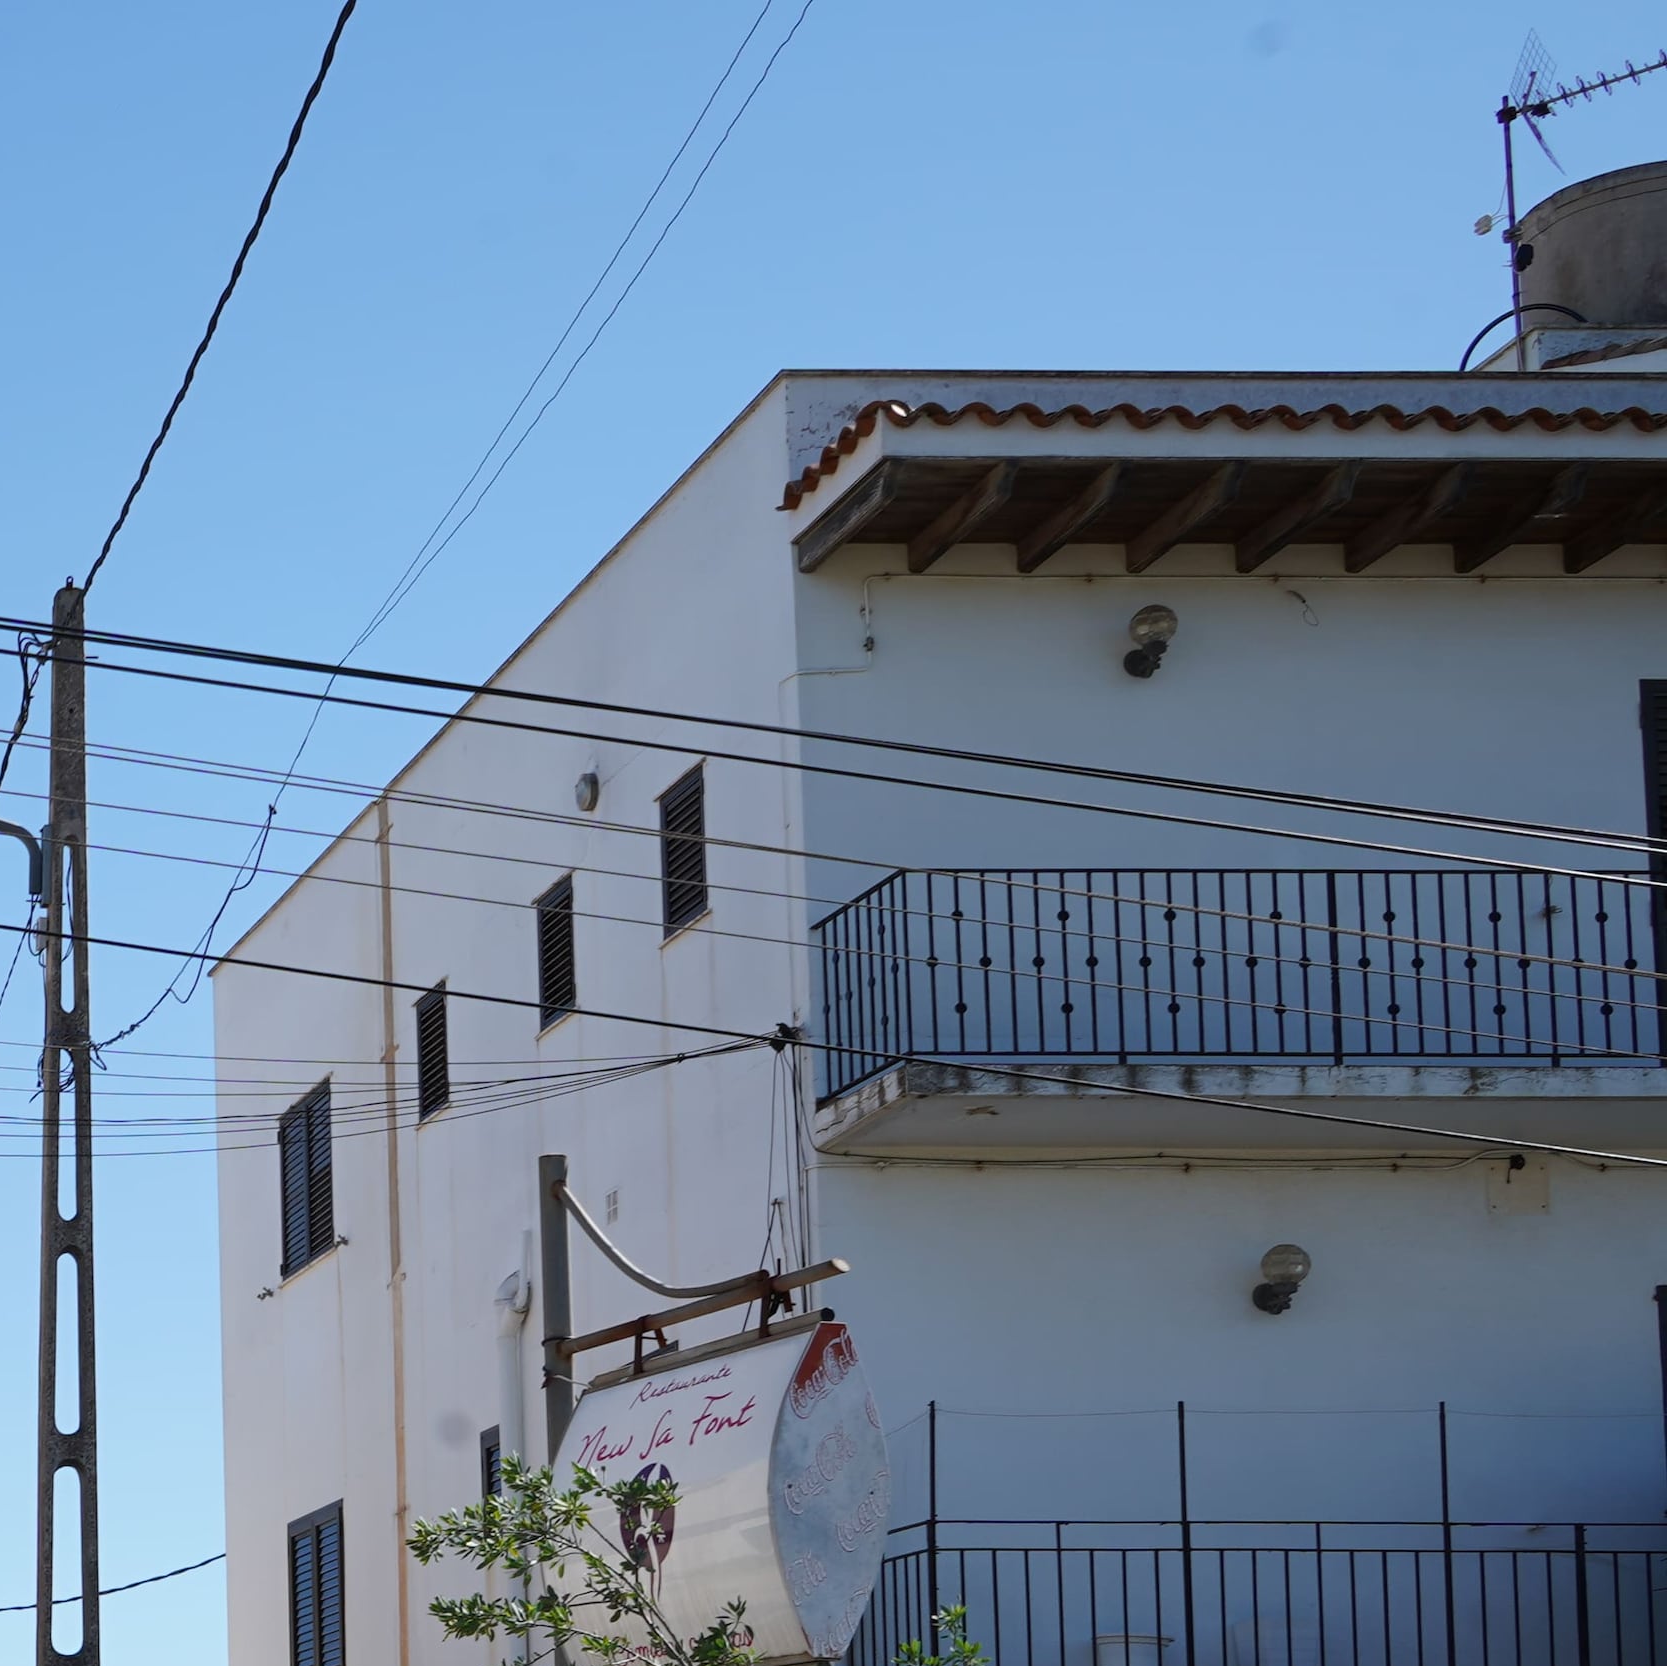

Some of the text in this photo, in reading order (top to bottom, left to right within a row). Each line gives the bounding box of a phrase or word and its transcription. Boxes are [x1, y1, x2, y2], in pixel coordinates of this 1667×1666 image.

[629, 1364, 732, 1410] Restaurante
[577, 1426, 633, 1471] New
[688, 1391, 756, 1446] Font
